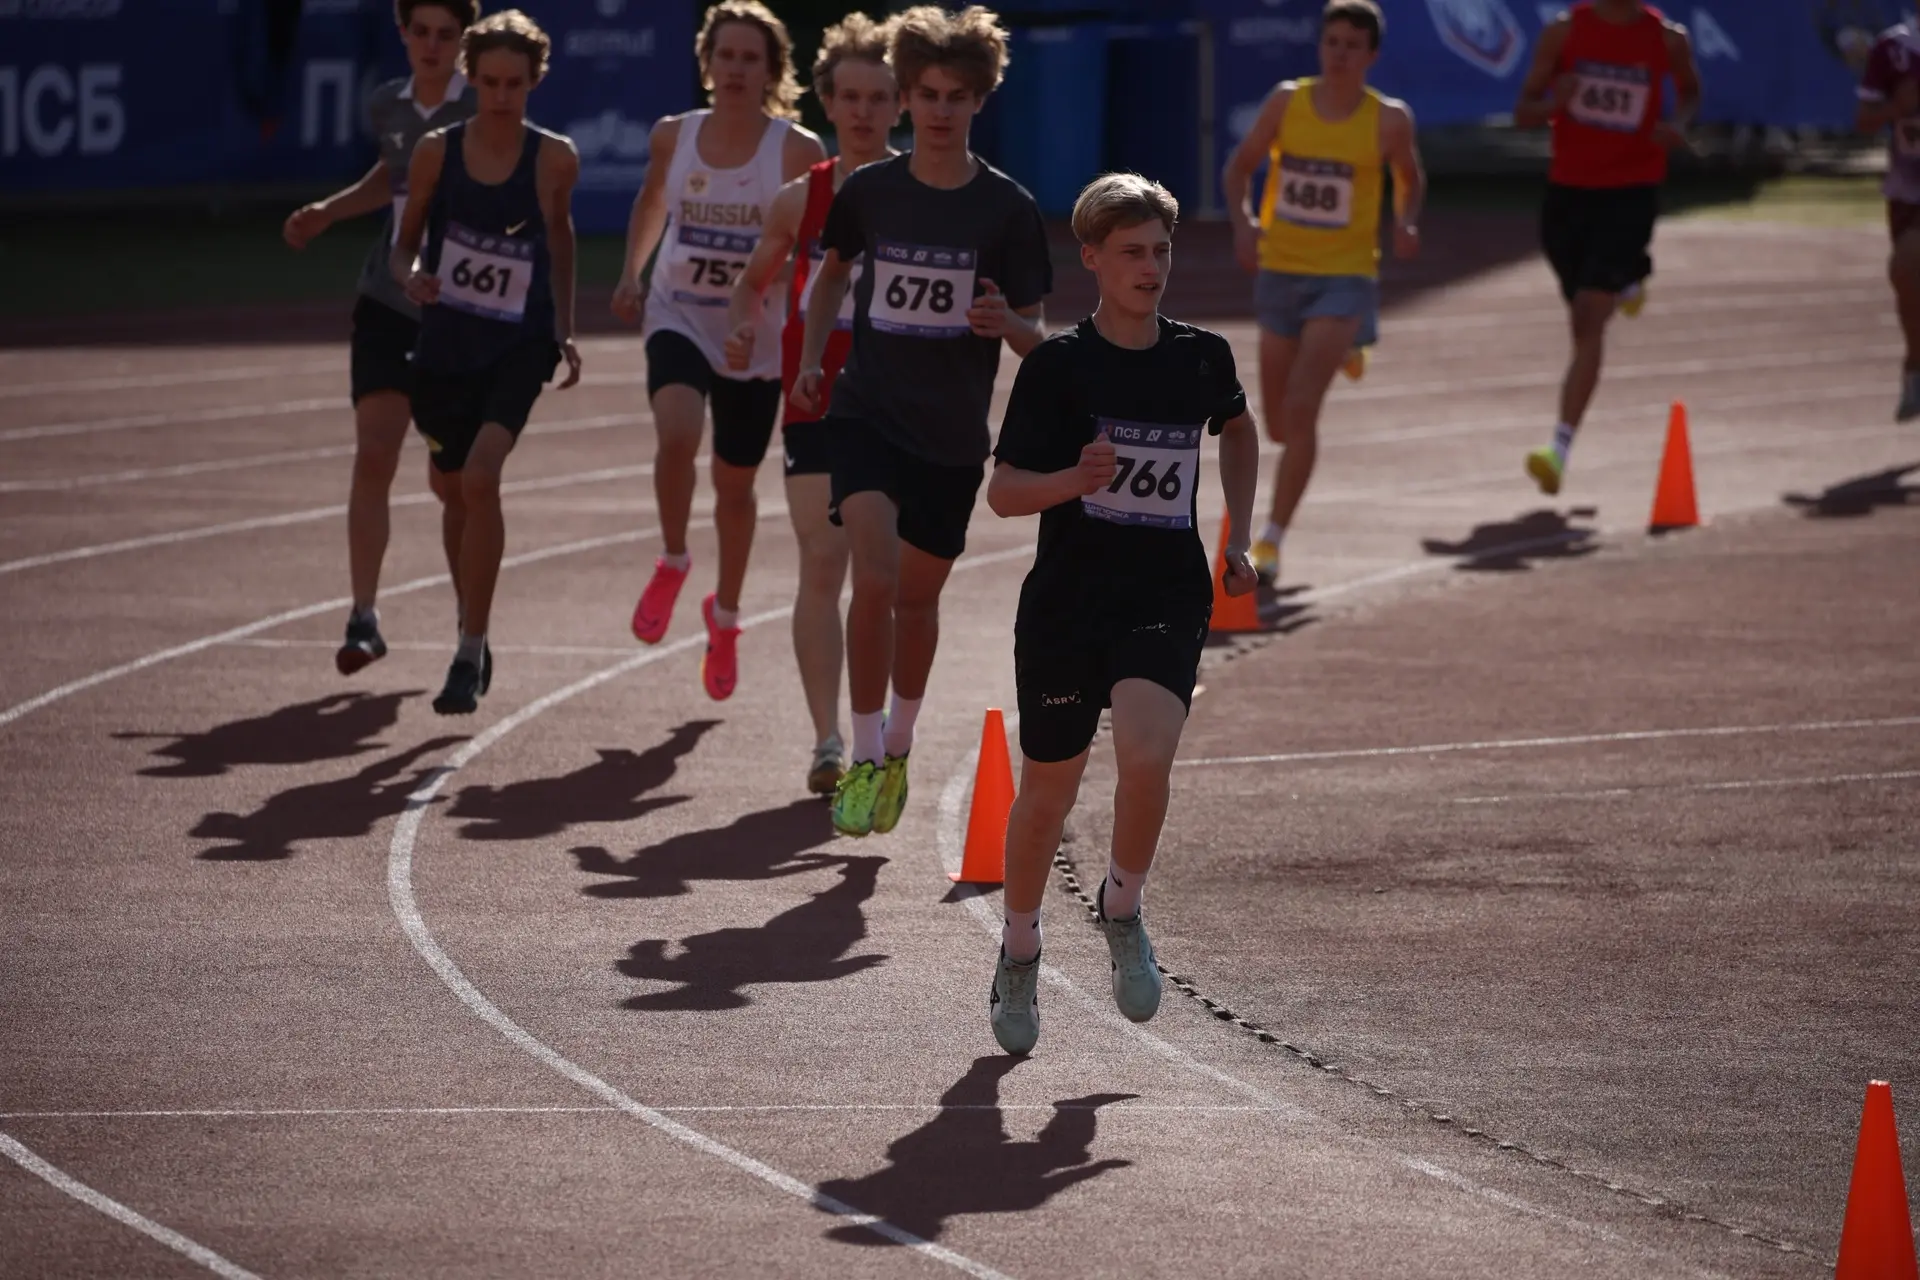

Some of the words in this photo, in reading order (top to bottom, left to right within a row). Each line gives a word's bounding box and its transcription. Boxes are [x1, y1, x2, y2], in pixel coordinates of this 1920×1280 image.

[680, 200, 763, 226] RUSSIA
[452, 257, 512, 298] 661
[885, 274, 954, 314] 678
[1114, 426, 1141, 440] ПСБ
[1107, 456, 1182, 501] 766
